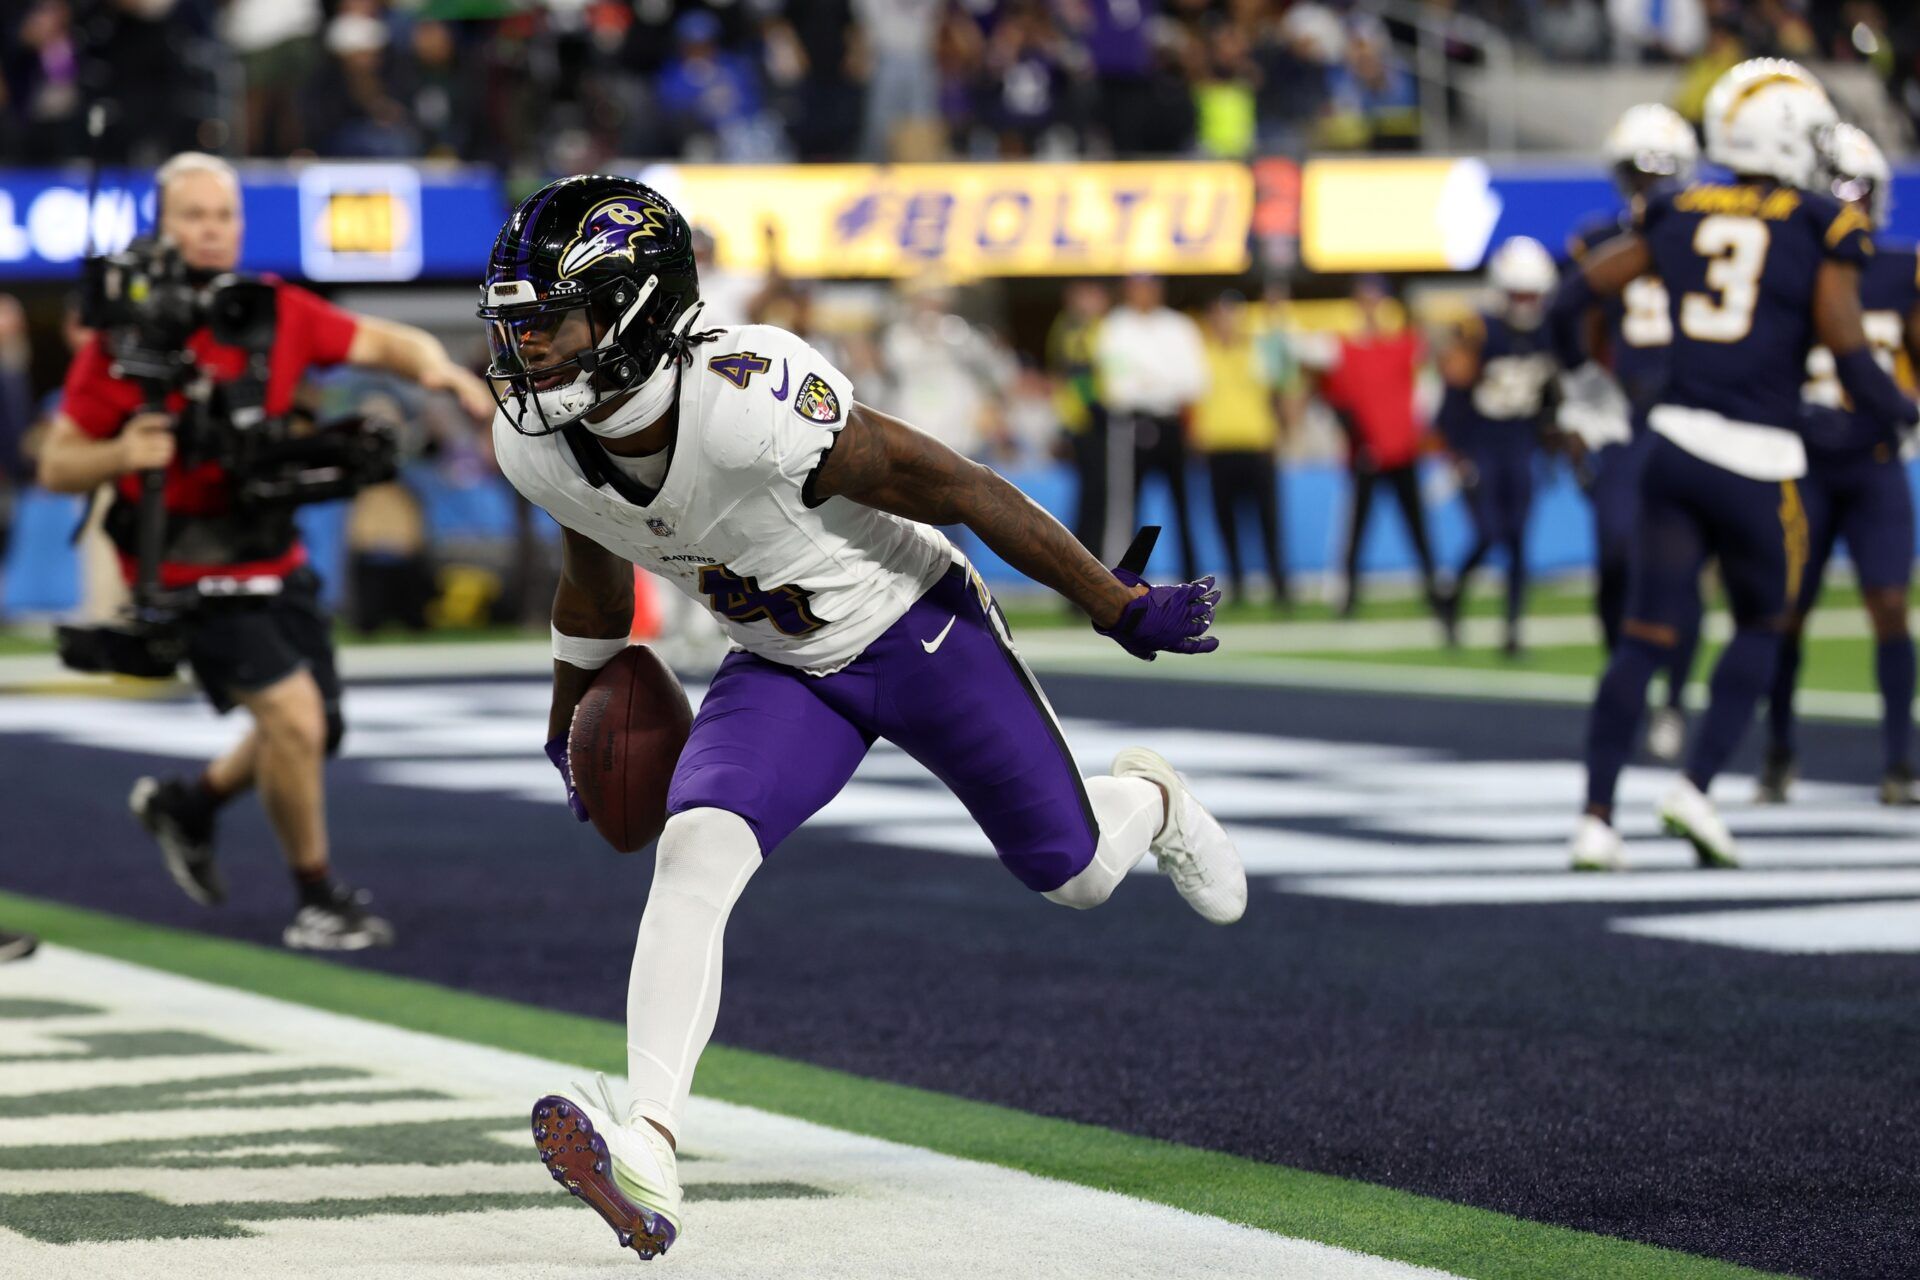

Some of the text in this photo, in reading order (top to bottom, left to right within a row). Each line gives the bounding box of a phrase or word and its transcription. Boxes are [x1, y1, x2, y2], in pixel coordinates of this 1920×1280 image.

[549, 288, 584, 296] OAKLEY
[1681, 214, 1771, 344] 3
[708, 351, 772, 390] 4
[796, 375, 814, 409] RAVENS
[659, 555, 716, 564] RAVENS
[698, 563, 832, 636] 4
